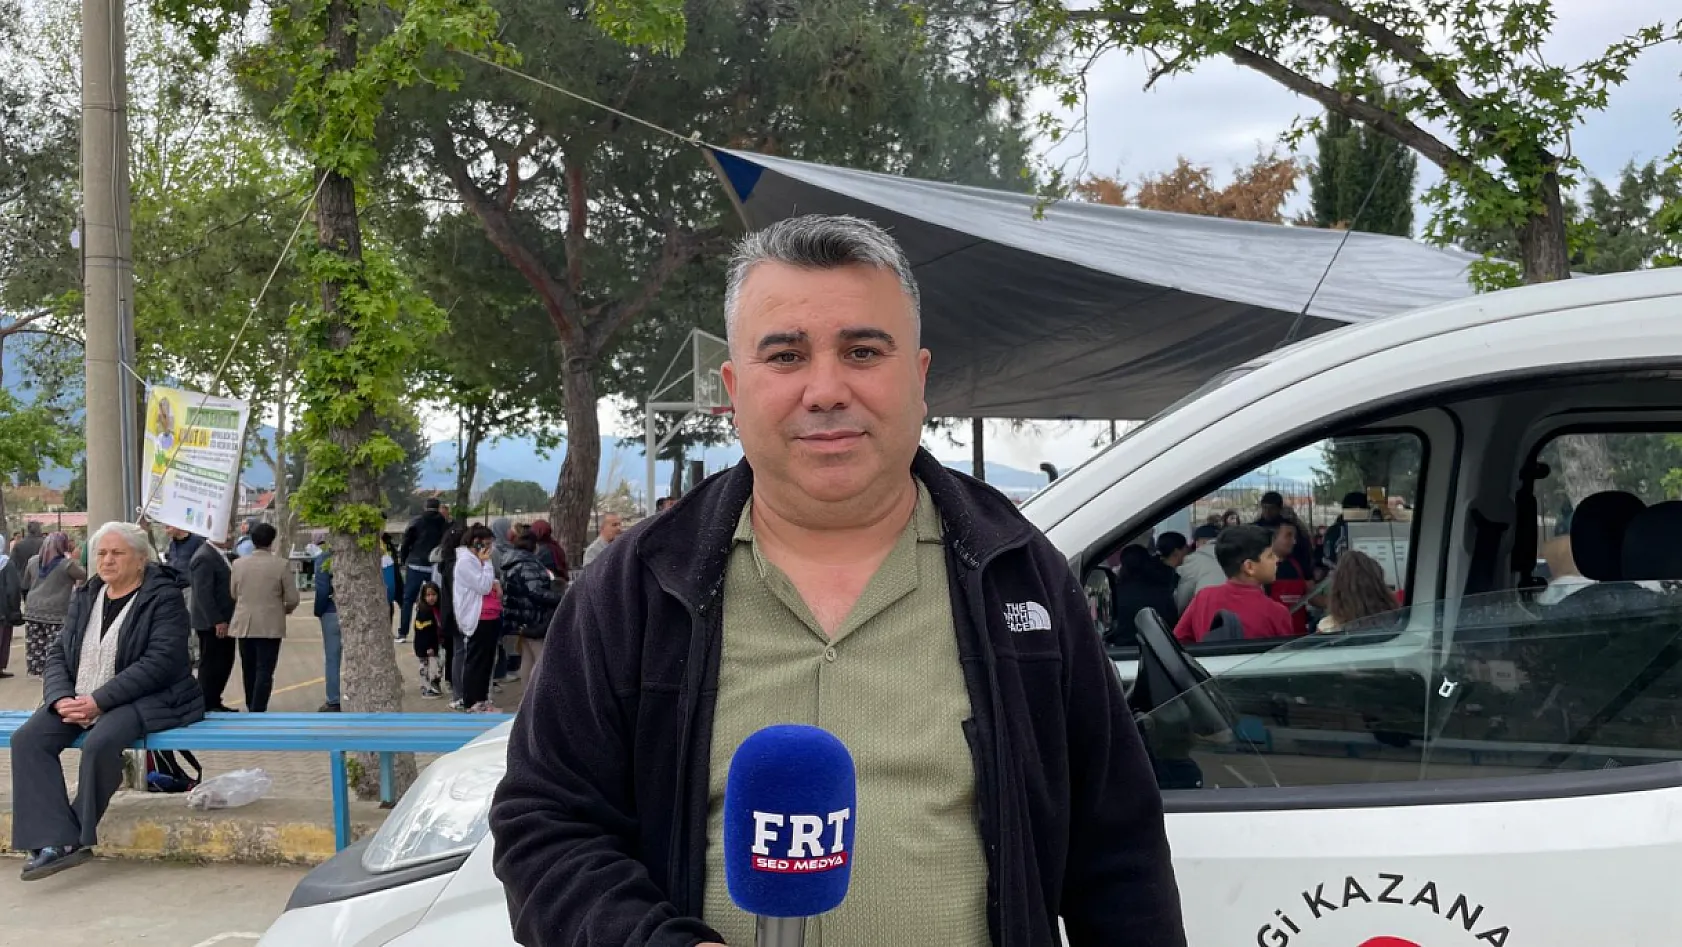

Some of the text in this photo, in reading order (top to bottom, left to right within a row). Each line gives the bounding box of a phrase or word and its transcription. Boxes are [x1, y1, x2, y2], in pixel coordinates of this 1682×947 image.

[1005, 602, 1026, 613] THE
[1003, 609, 1028, 622] RTH
[752, 807, 850, 857] FRT
[756, 855, 844, 870] SED MEDYA
[1302, 873, 1510, 947] KAZANA
